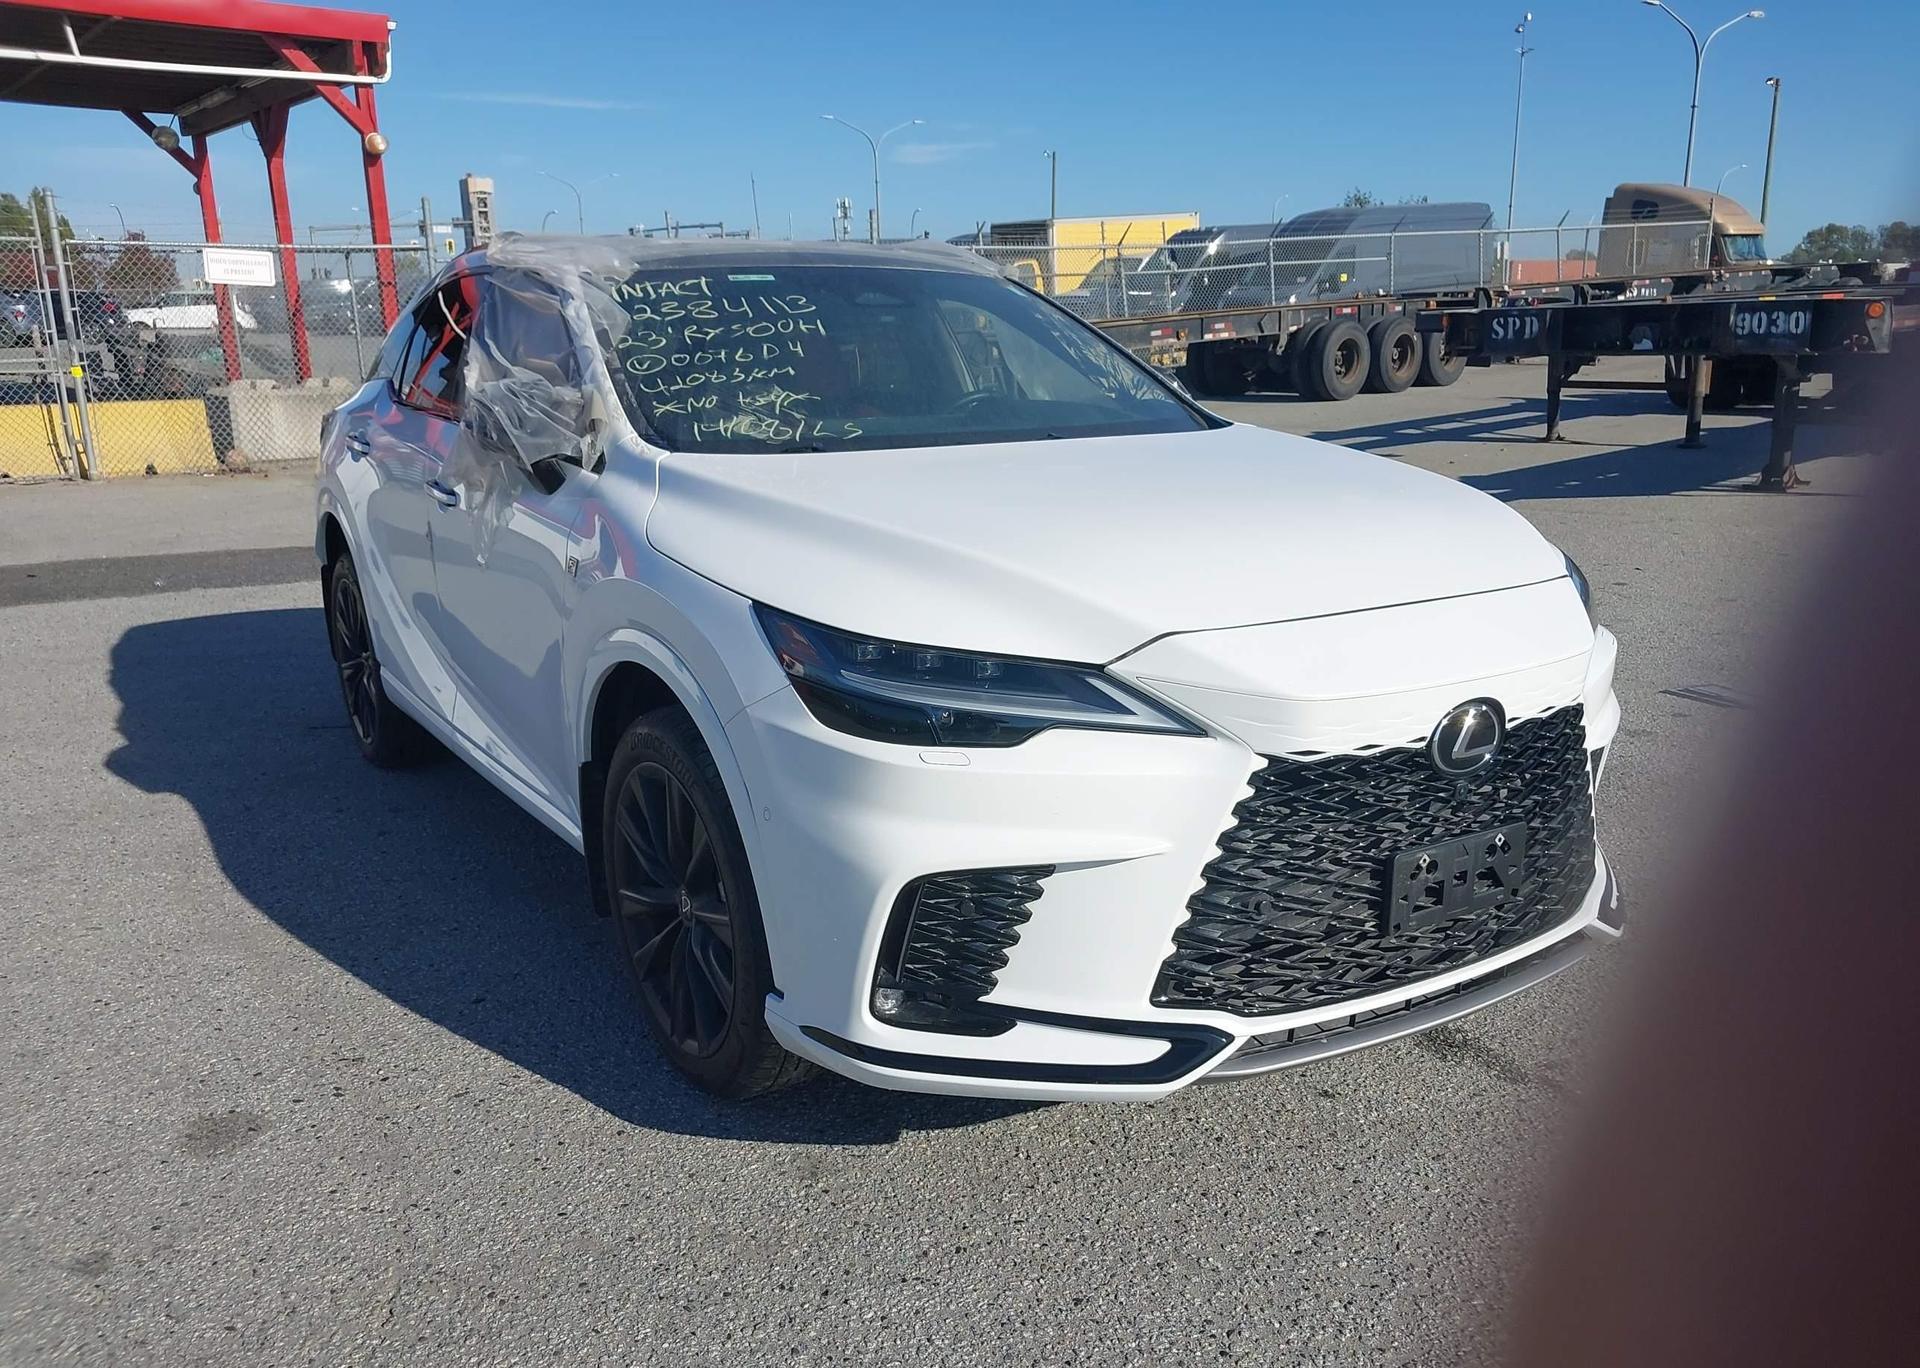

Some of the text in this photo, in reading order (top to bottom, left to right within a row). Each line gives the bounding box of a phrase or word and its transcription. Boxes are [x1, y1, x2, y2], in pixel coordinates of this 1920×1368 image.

[611, 276, 713, 302] INTACT
[1492, 316, 1539, 339] SPD
[1736, 311, 1805, 335] 9030
